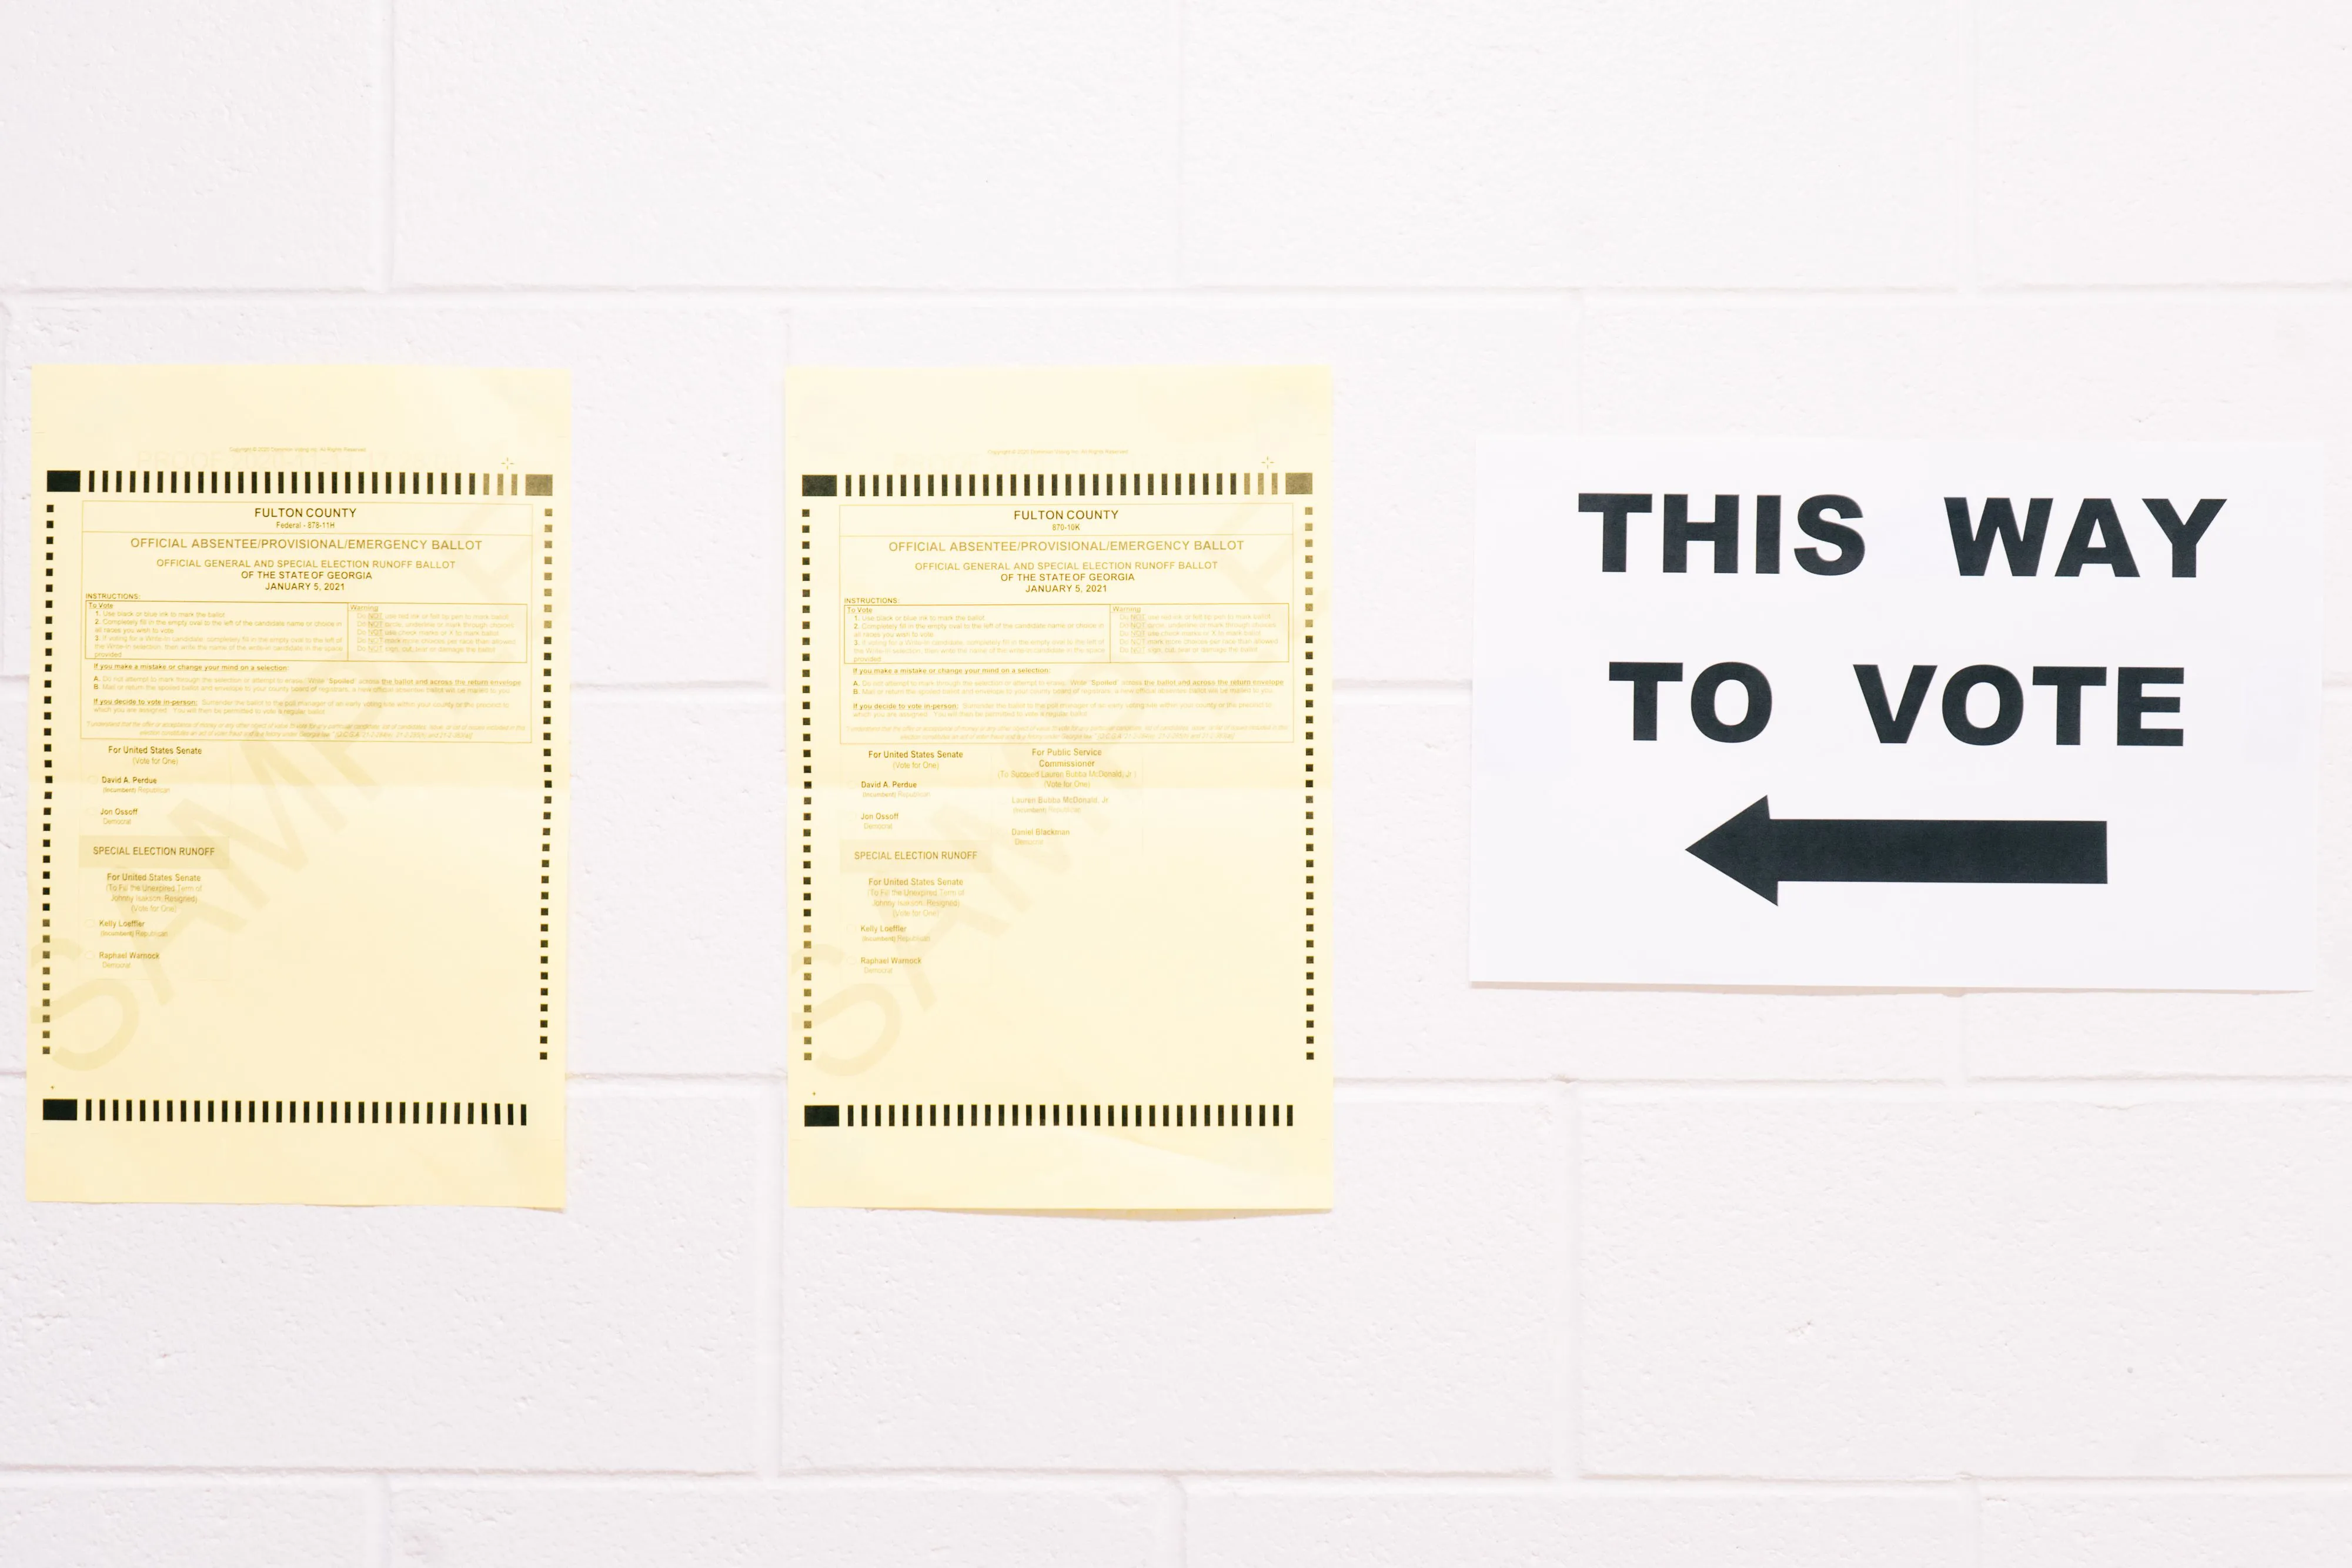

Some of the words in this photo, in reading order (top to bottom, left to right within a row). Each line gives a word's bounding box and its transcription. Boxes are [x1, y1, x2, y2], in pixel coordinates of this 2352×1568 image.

[255, 508, 303, 517] FULTON
[306, 508, 356, 517] COUNTY
[1014, 510, 1063, 520] FULTON
[1067, 510, 1118, 519] COUNTY
[1579, 494, 1865, 576] THIS
[1945, 497, 2227, 577] WAY
[131, 538, 186, 548] OFFICIAL
[192, 539, 426, 549] ABSENTEE/PROVISIONAL/EMERGENCY
[432, 540, 482, 550] BALLOT
[889, 542, 946, 551] OFFICIAL
[950, 541, 1189, 551] ABSENTEE/PROVISIONAL/EMERGENCY
[1194, 541, 1243, 550] BALLOT
[156, 559, 201, 567] OFFICIAL
[963, 562, 1010, 570] GENERAL
[1075, 584, 1082, 593] 5,
[1609, 662, 1772, 743] TO
[1853, 665, 2184, 746] VOTE
[93, 847, 129, 855] SPECIAL
[133, 847, 176, 855] ELECTION
[179, 847, 215, 855] RUNOFF
[854, 851, 891, 860] SPECIAL
[894, 851, 938, 860] ELECTION
[941, 851, 977, 860] RUNOFF
